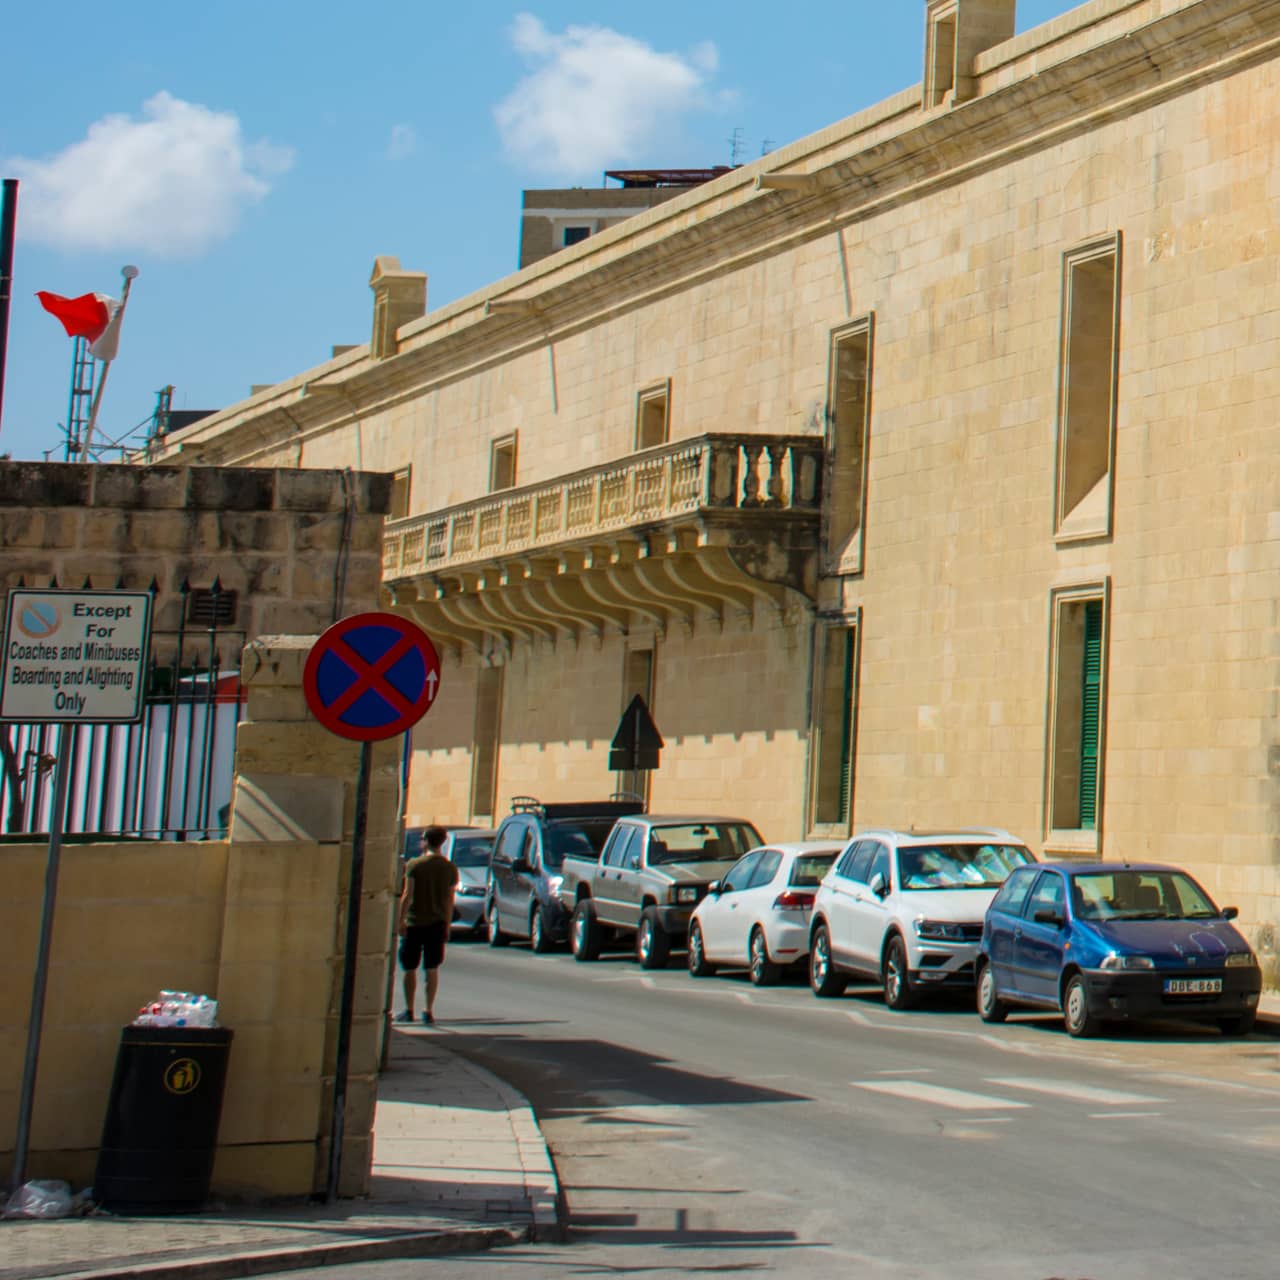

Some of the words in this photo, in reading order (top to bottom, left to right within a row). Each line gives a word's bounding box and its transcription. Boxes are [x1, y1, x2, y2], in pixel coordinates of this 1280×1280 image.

[73, 603, 132, 620] Except
[86, 624, 116, 638] For
[10, 641, 58, 660] Coaches
[61, 641, 82, 660] and
[84, 642, 140, 661] Minibuses
[12, 666, 61, 689] Boarding
[63, 666, 84, 684] and
[86, 666, 134, 690] Alighting
[55, 691, 86, 714] Only
